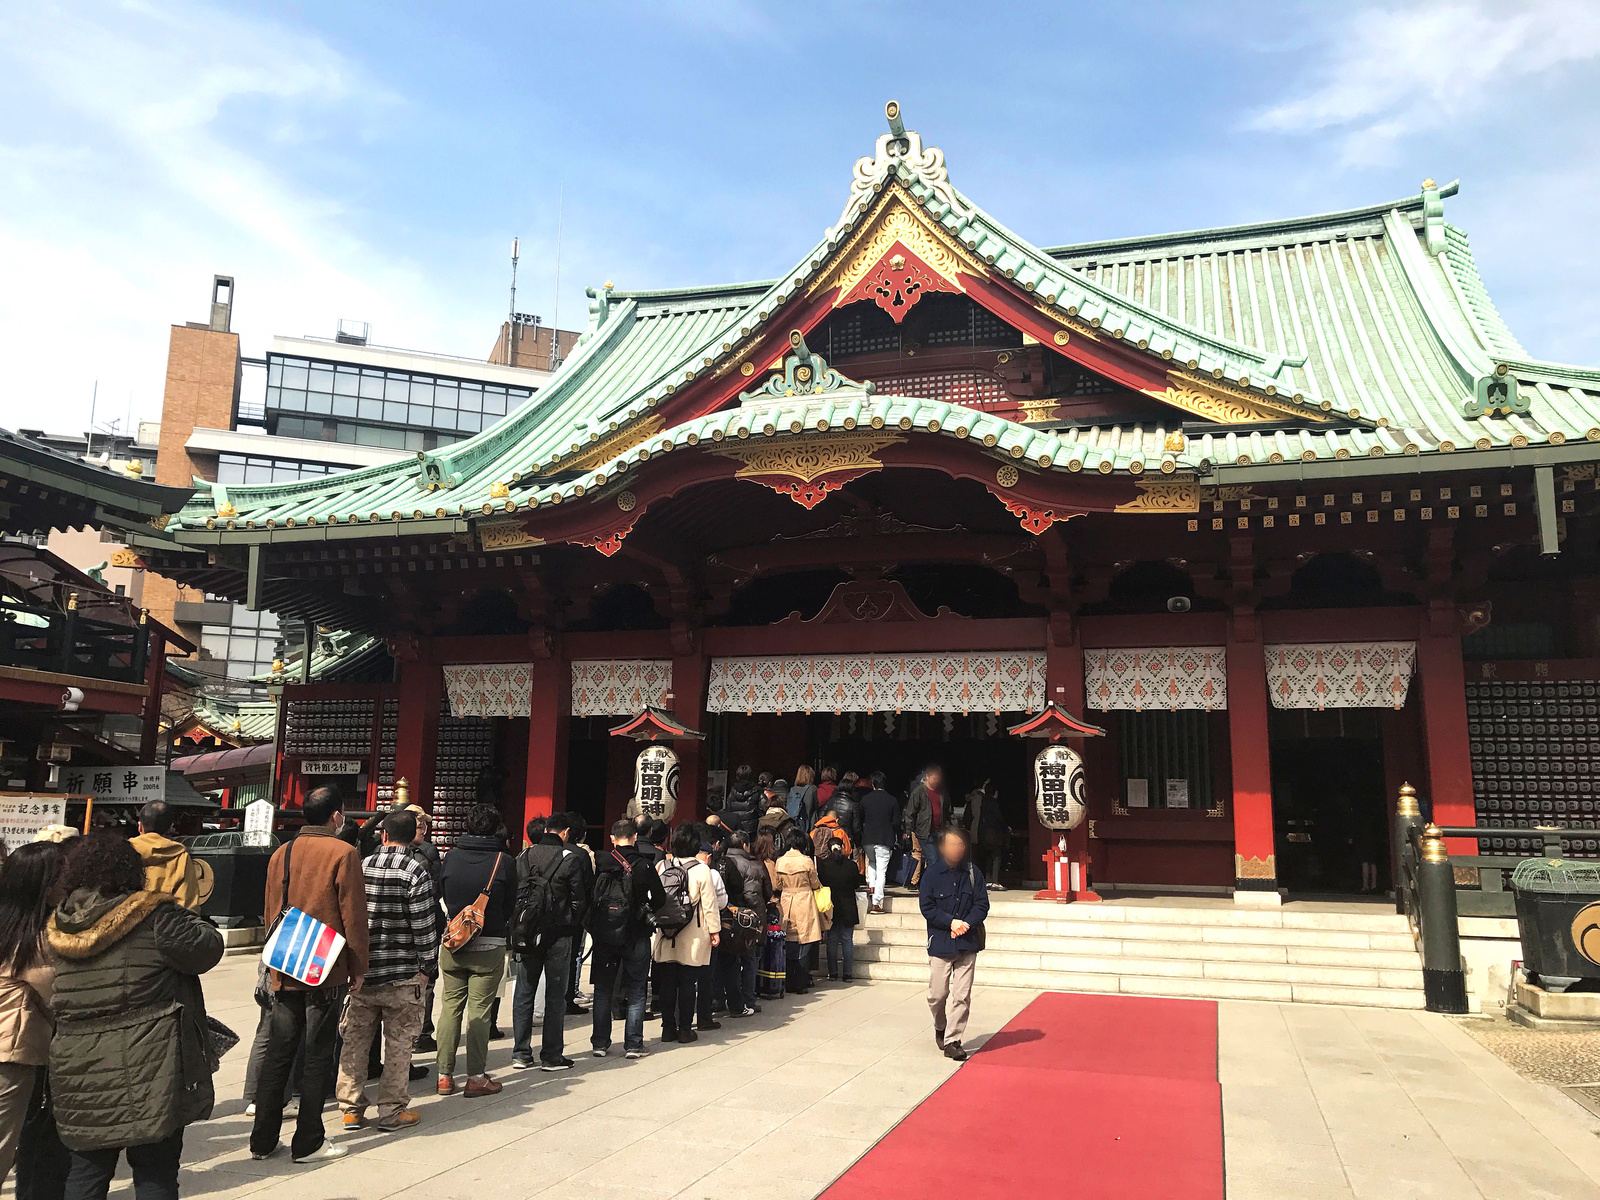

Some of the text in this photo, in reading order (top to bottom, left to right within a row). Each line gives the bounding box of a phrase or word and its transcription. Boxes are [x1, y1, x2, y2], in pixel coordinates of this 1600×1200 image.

[304, 762, 347, 772] 資料館受付
[65, 770, 139, 795] 祈願串
[641, 758, 665, 816] 神田明神
[1039, 760, 1070, 824] 神田明神
[18, 803, 61, 815] 記念事業
